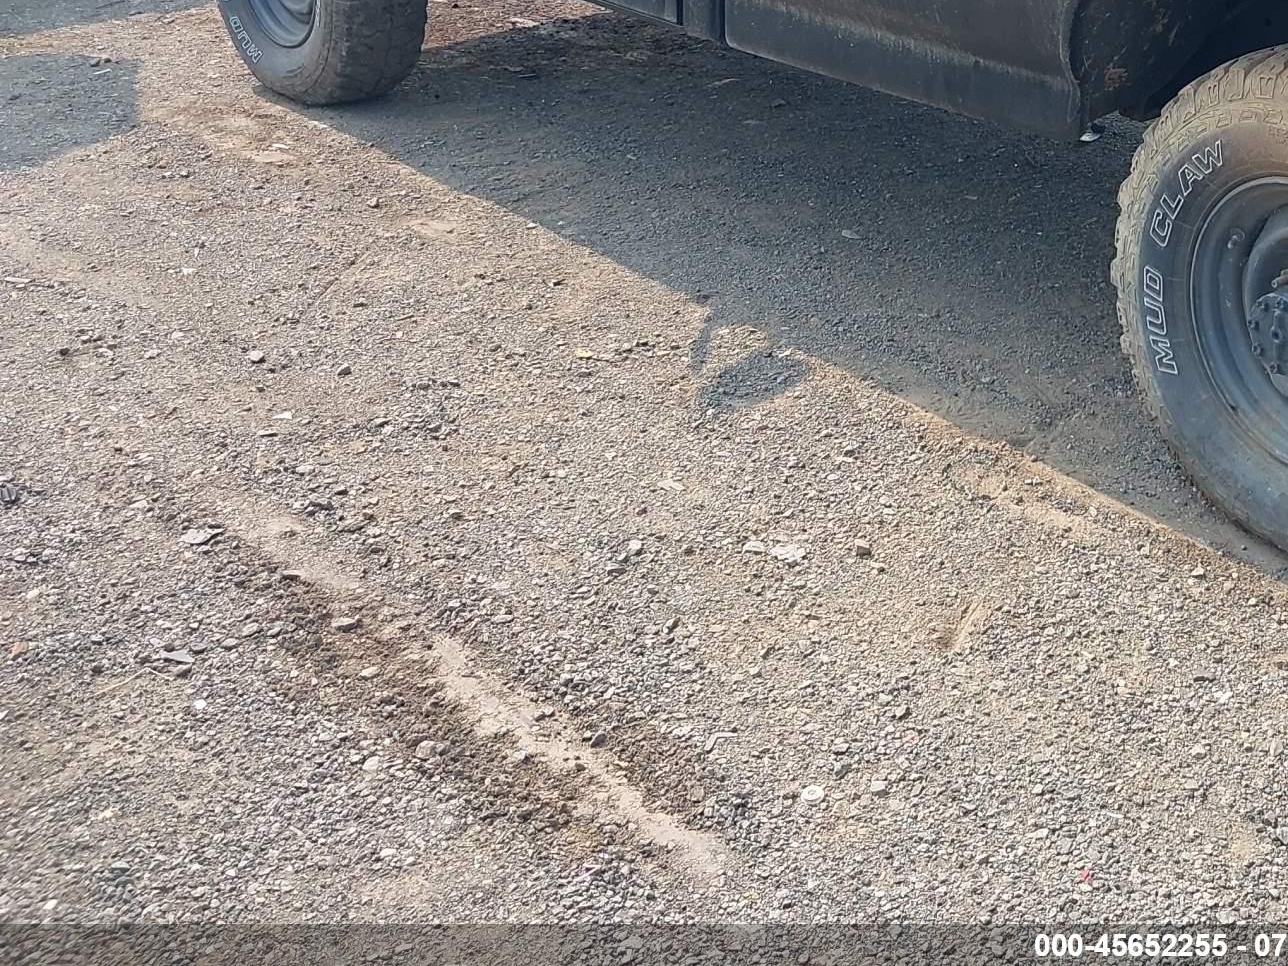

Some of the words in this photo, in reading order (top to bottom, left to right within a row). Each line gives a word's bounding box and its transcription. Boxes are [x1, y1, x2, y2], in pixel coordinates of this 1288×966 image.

[229, 16, 263, 64] MUD
[1149, 140, 1224, 248] CLAW
[1143, 265, 1178, 376] MUD
